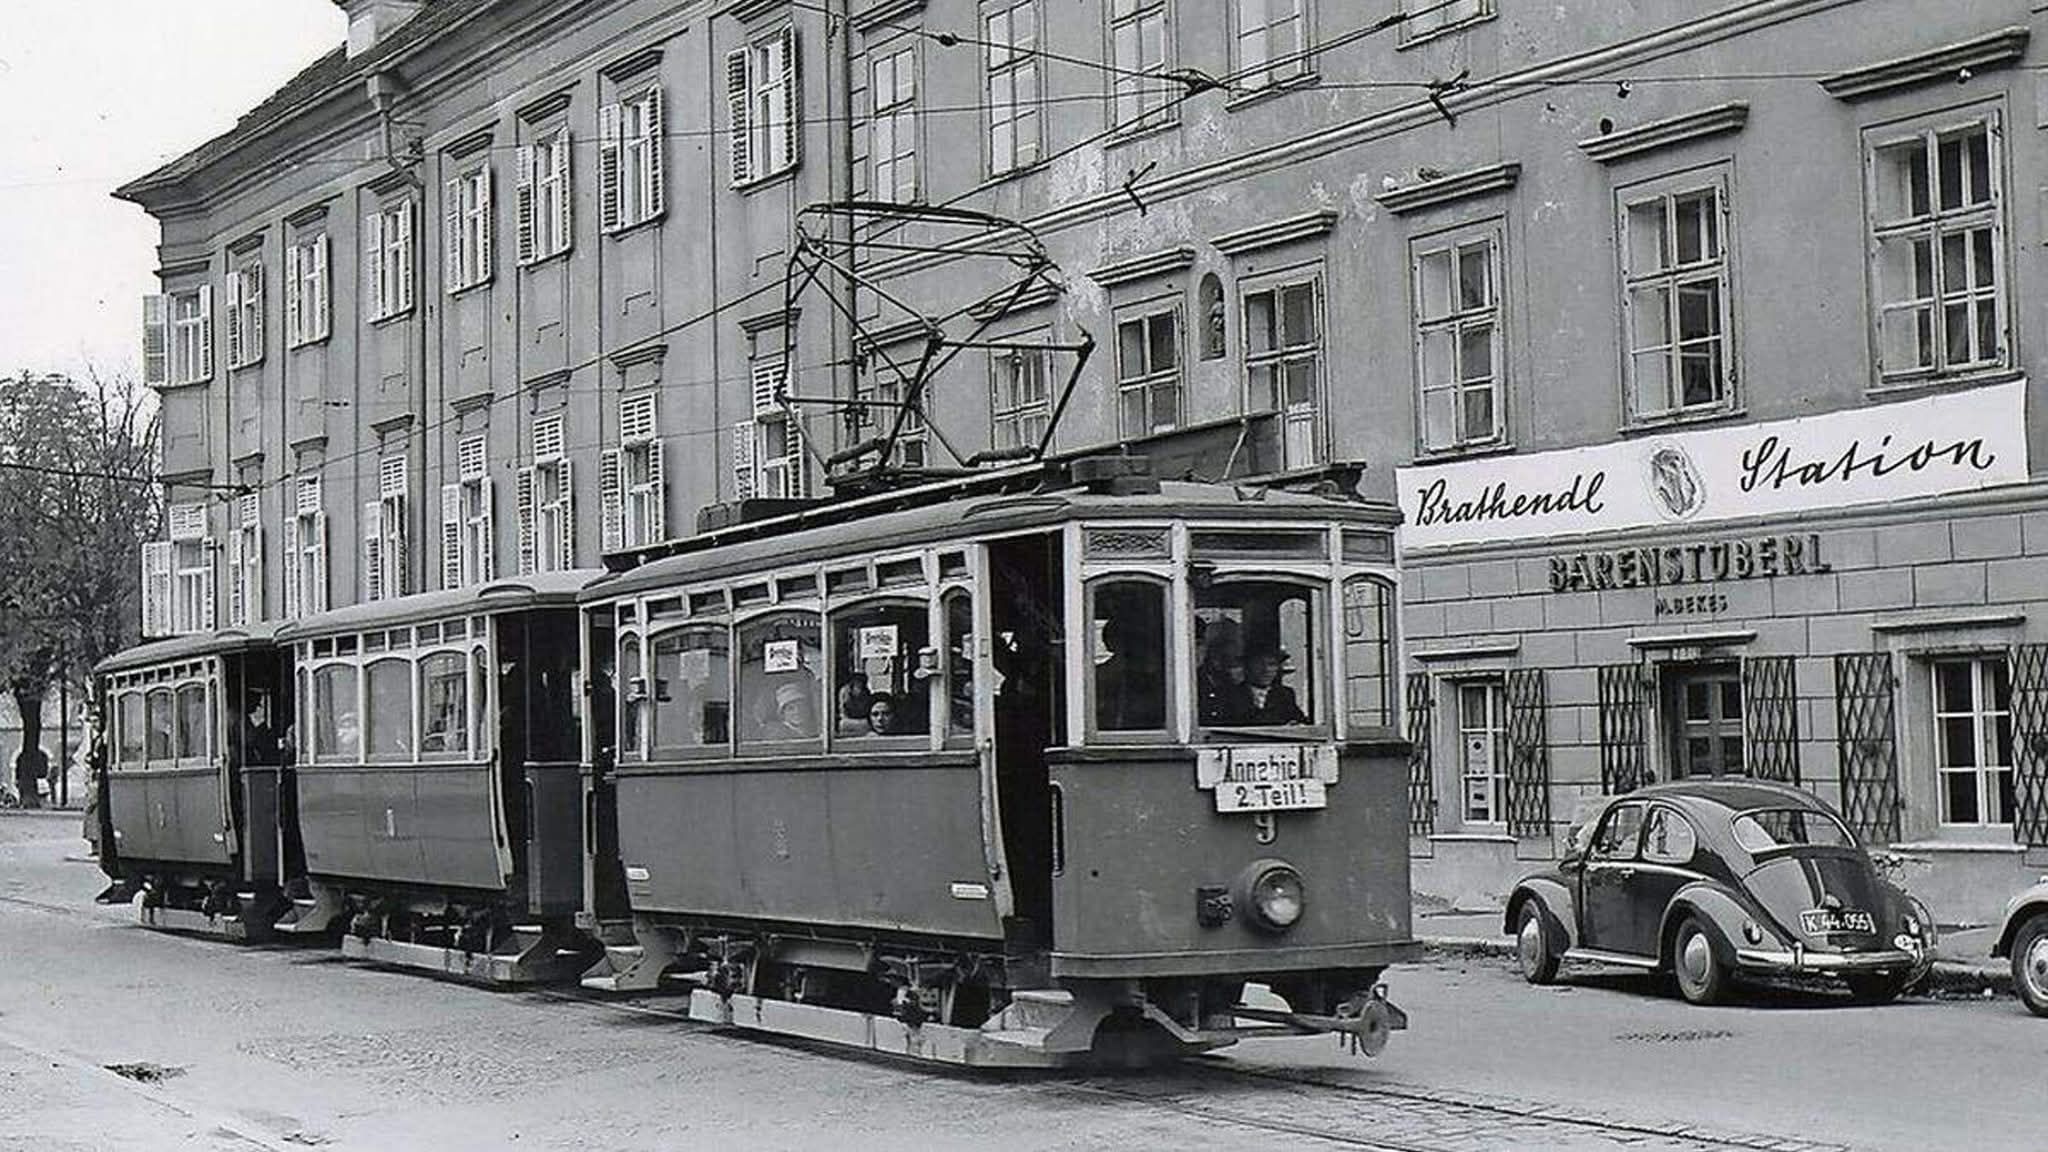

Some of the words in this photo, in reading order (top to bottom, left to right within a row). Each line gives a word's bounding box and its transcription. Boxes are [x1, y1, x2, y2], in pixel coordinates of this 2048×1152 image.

[1415, 471, 1605, 526] Brathendl
[1740, 435, 1996, 492] Station
[1235, 785, 1255, 808] 2.
[1255, 783, 1307, 806] Teil!
[1804, 913, 1819, 932] K
